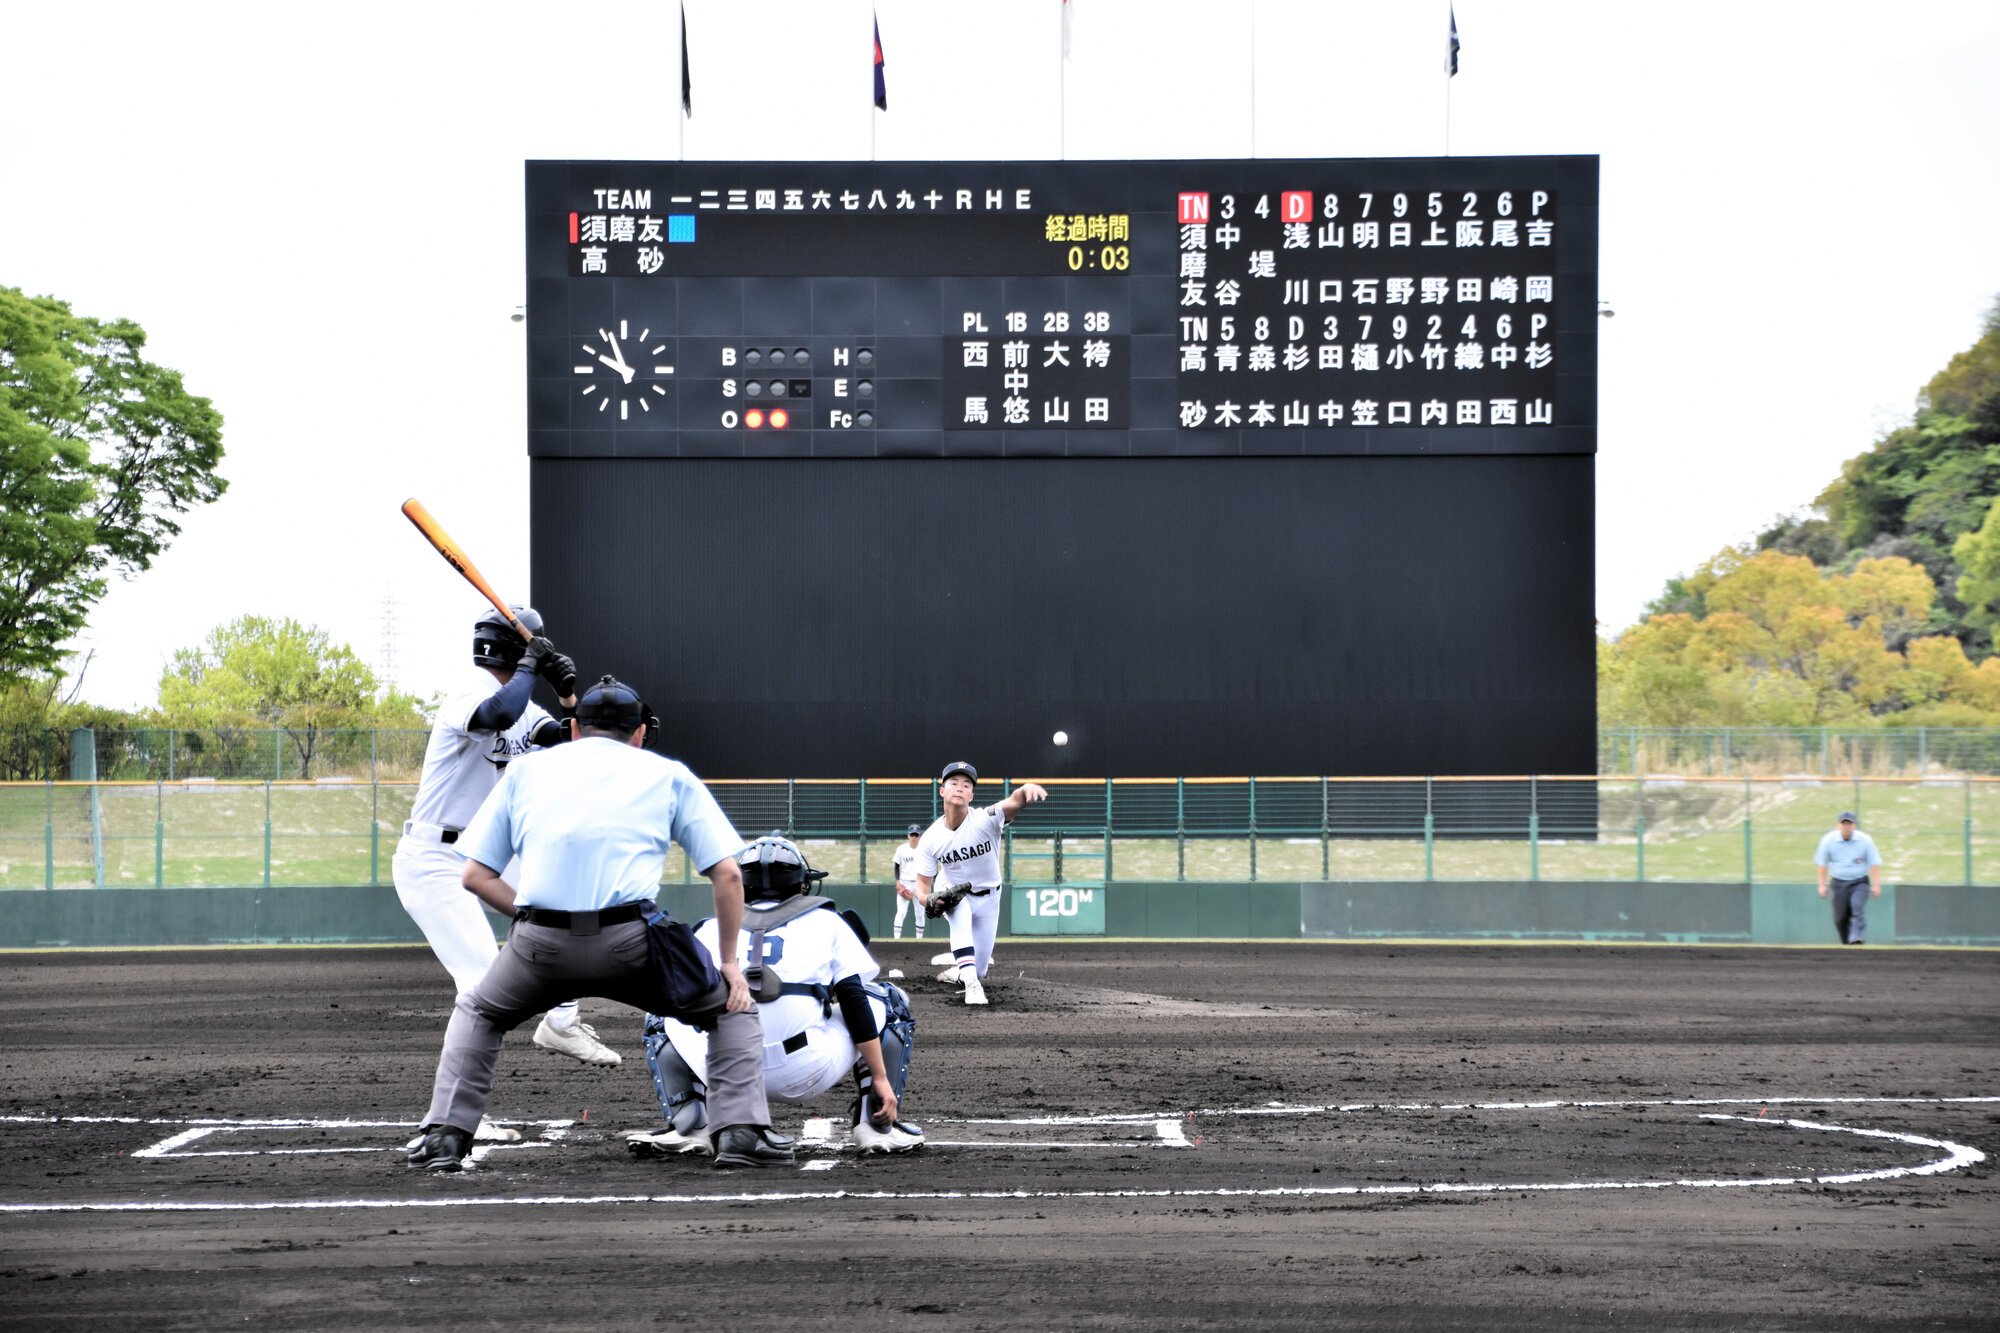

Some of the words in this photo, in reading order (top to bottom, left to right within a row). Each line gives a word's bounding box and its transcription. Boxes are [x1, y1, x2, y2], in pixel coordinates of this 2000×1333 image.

[581, 215, 663, 242] 須磨友
[594, 189, 651, 209] TEAM
[957, 190, 972, 209] R
[986, 190, 1002, 209] H
[1016, 190, 1030, 209] E
[1046, 215, 1128, 241] 経過時間
[1180, 195, 1207, 219] TN
[1221, 196, 1234, 219] 3
[1255, 195, 1269, 218] 4
[1290, 194, 1304, 218] D
[1324, 194, 1338, 218] 8
[1359, 194, 1372, 217] 7
[1394, 194, 1407, 217] 9
[1428, 193, 1442, 217] 5
[1463, 193, 1477, 216] 2
[1498, 192, 1512, 215] 6
[1533, 191, 1547, 215] P
[1180, 224, 1207, 306] 須磨友
[1214, 223, 1240, 305] 中谷
[1248, 251, 1276, 278] 堤
[1283, 223, 1310, 304] 浅川
[1319, 222, 1344, 303] 山口
[1352, 222, 1379, 304] 明石
[1386, 223, 1415, 304] 日野
[1421, 221, 1449, 304] 上野
[1456, 221, 1484, 302] 阪田
[1490, 220, 1518, 303] 尾崎
[1526, 219, 1553, 302] 吉岡
[723, 348, 736, 365] B
[834, 348, 848, 365] H
[964, 313, 988, 332] PL
[1006, 312, 1027, 332] 1B
[1044, 312, 1069, 332] 2B
[1084, 312, 1109, 331] 3B
[1180, 317, 1207, 341] TN
[1221, 317, 1234, 341] 5
[1255, 317, 1269, 340] 8
[1290, 316, 1303, 340] D
[1324, 316, 1338, 340] 3
[1359, 316, 1372, 340] 7
[1393, 316, 1407, 339] 9
[1428, 315, 1441, 339] 2
[1461, 315, 1476, 338] 4
[1497, 315, 1511, 338] 6
[1532, 314, 1546, 338] P
[722, 411, 738, 428] O
[723, 379, 736, 397] S
[831, 410, 852, 428] Fc
[835, 379, 847, 396] E
[963, 342, 988, 423] 西馬
[1044, 341, 1069, 422] 大山
[1180, 344, 1207, 427] 高砂
[1214, 344, 1241, 427] 青木
[1248, 344, 1276, 427] 森本
[1283, 343, 1309, 426] 杉山
[1319, 345, 1343, 426] 田中
[1386, 344, 1413, 424] 小口
[1421, 343, 1448, 425] 竹内
[1490, 342, 1517, 425] 中西
[1525, 341, 1552, 424] 杉山
[483, 644, 491, 656] 7
